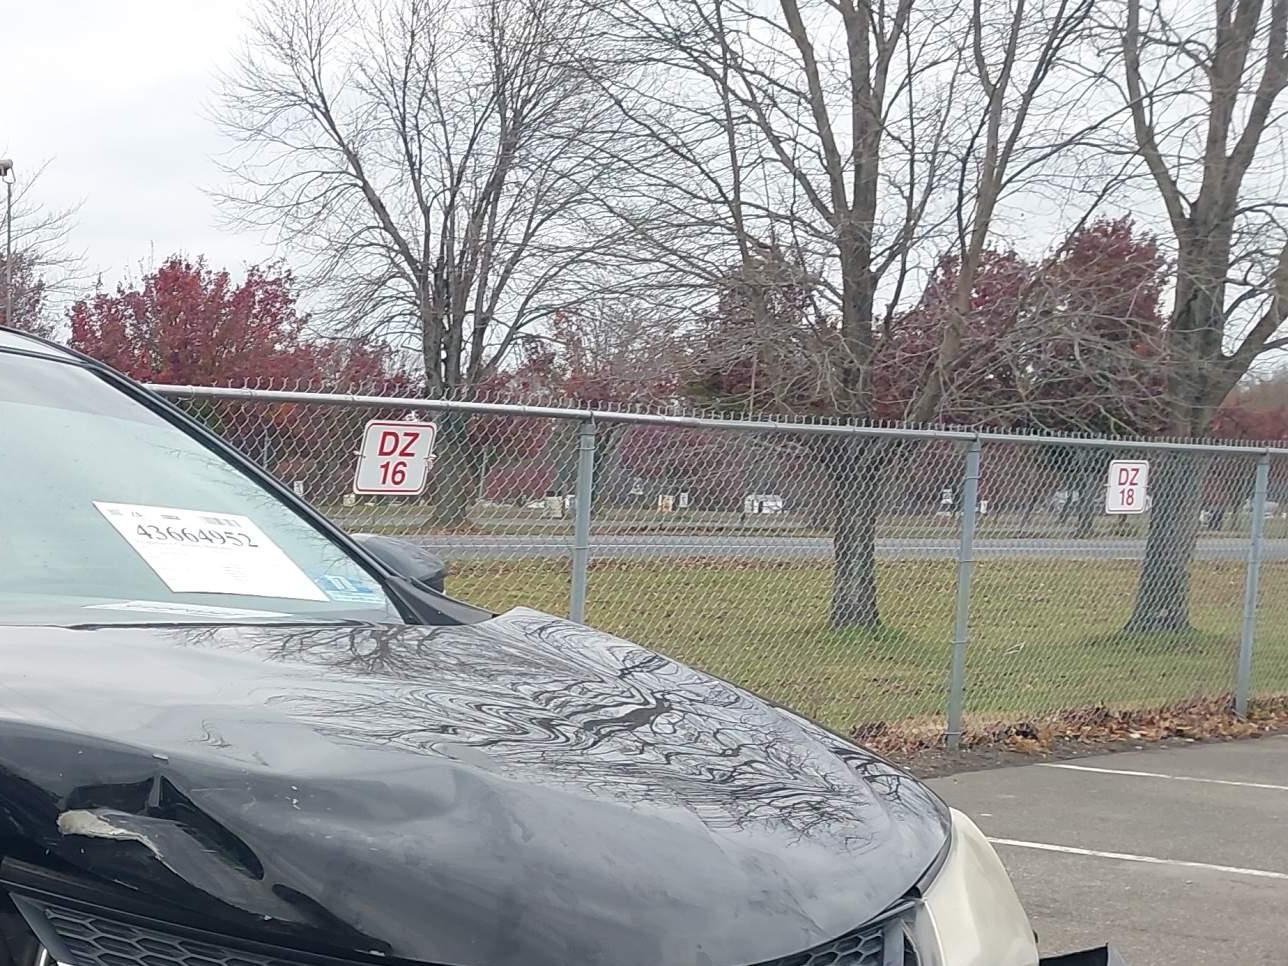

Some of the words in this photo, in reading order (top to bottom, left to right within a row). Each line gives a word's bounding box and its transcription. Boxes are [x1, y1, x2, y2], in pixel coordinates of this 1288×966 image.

[378, 431, 420, 457] DZ
[379, 461, 408, 485] 16
[1118, 467, 1140, 486] DZ
[1119, 488, 1135, 506] 18
[136, 523, 259, 548] 43664952
